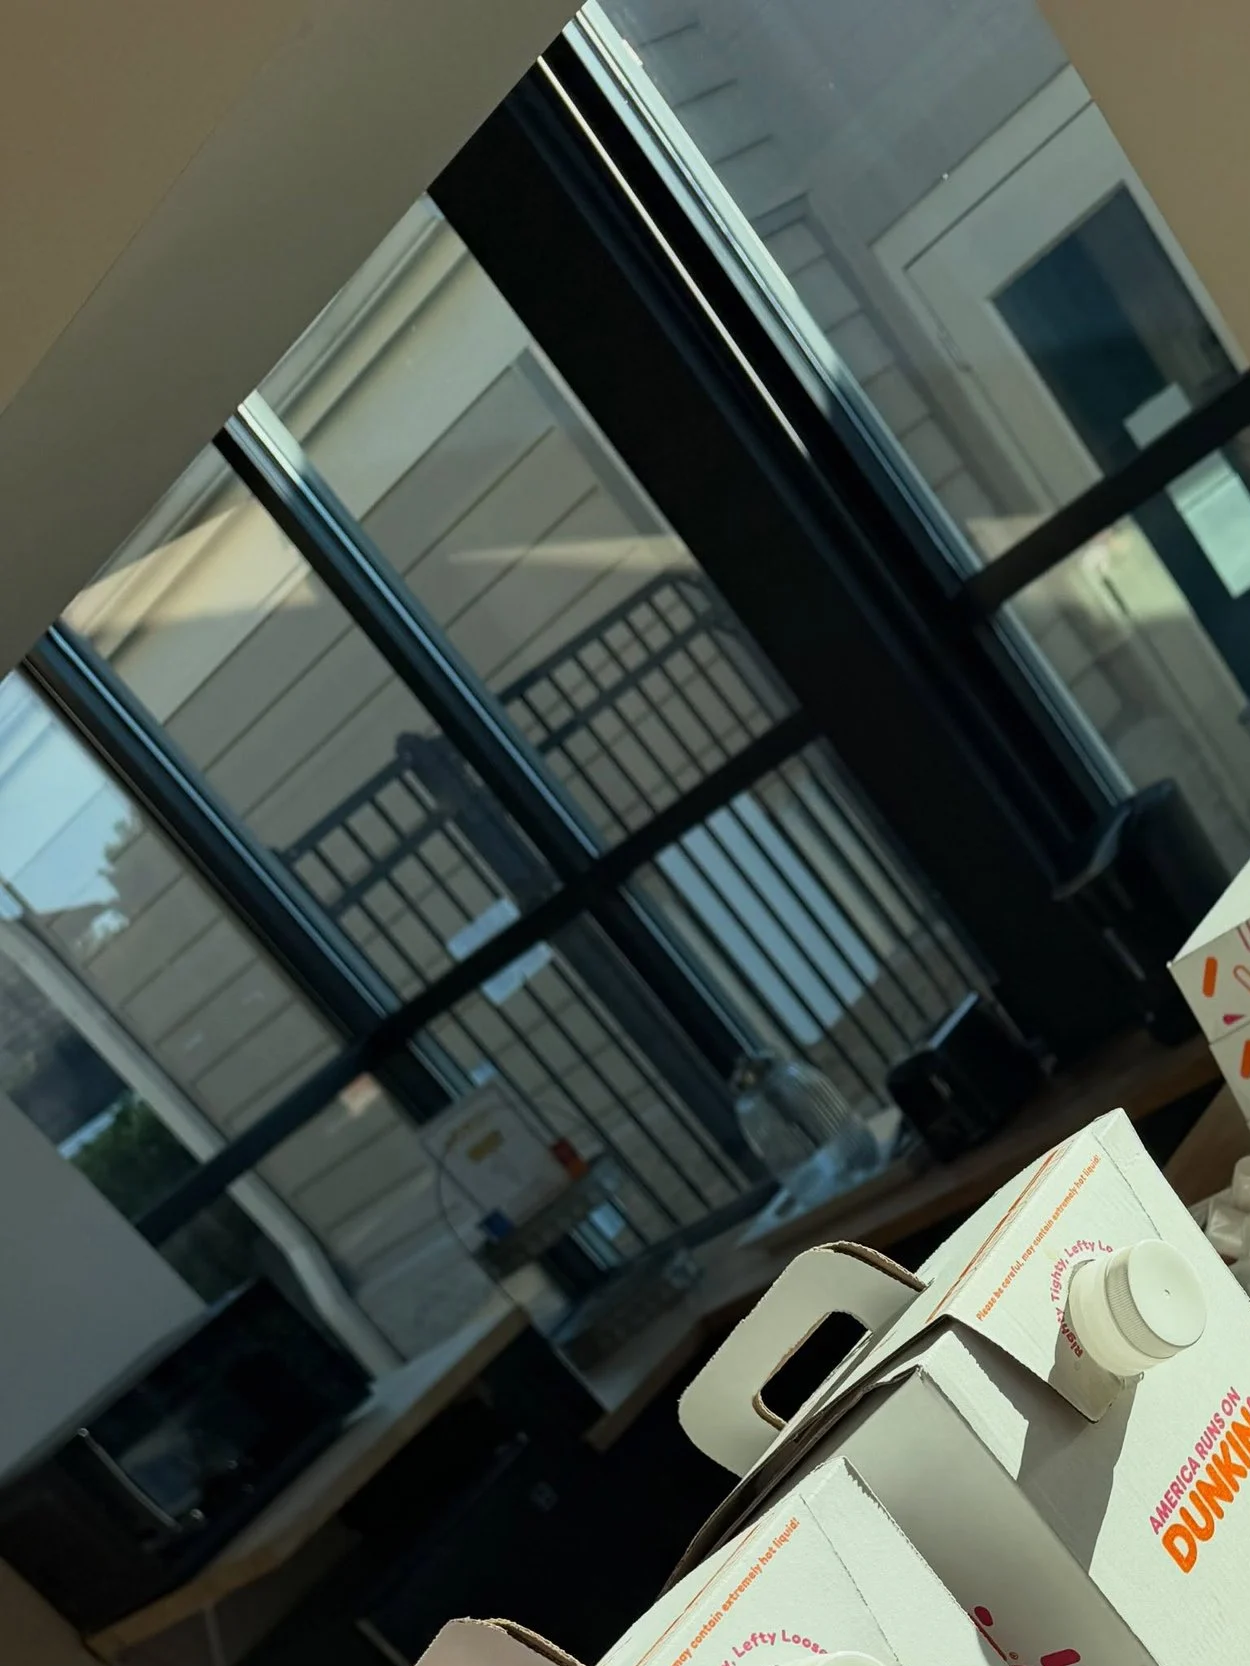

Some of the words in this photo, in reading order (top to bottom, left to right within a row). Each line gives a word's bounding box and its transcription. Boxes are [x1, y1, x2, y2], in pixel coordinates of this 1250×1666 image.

[976, 1297, 997, 1321] Please
[993, 1287, 1004, 1298] be
[1022, 1245, 1036, 1262] may
[1033, 1219, 1054, 1246] contain
[1052, 1187, 1079, 1221] extremely
[1074, 1174, 1087, 1190] hot
[1064, 1240, 1095, 1258] Lefty
[1149, 1456, 1200, 1535] AMERICA
[1194, 1412, 1226, 1460] RUNS
[1221, 1386, 1241, 1416] ON
[690, 1611, 723, 1649] contain
[721, 1564, 763, 1612] extremely
[758, 1546, 776, 1566] hot
[772, 1517, 800, 1548] liquid!
[732, 1631, 777, 1658] Lefty
